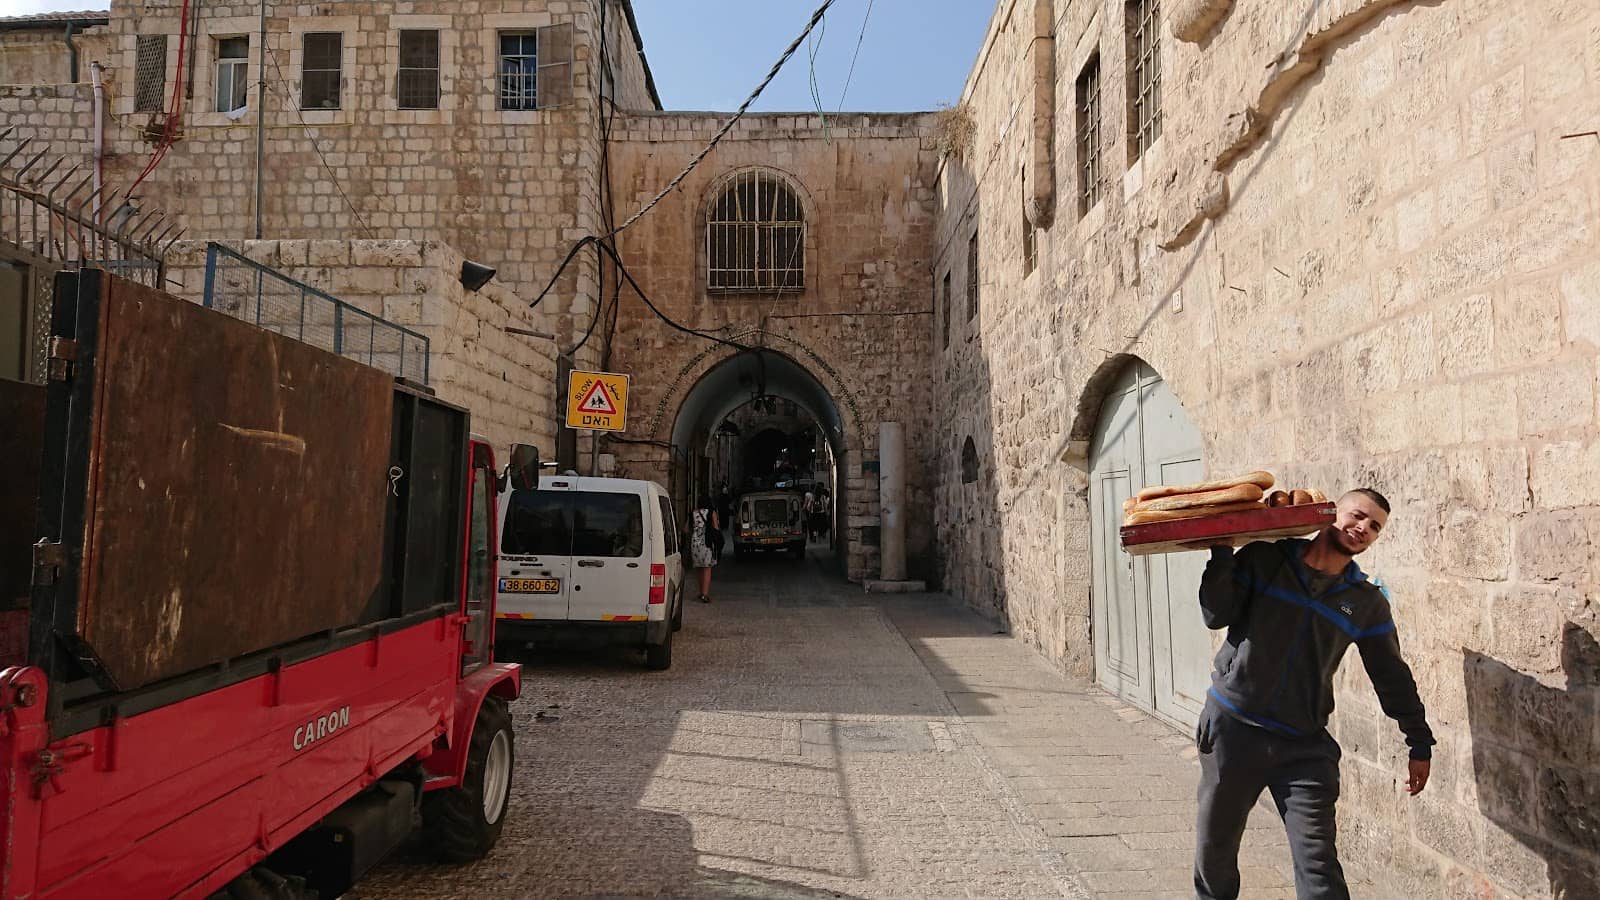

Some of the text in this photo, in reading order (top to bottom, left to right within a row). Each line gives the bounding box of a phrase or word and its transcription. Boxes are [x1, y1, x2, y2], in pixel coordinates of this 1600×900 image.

[575, 378, 593, 401] SLOW
[582, 415, 610, 427] האט
[293, 706, 350, 751] CARON
